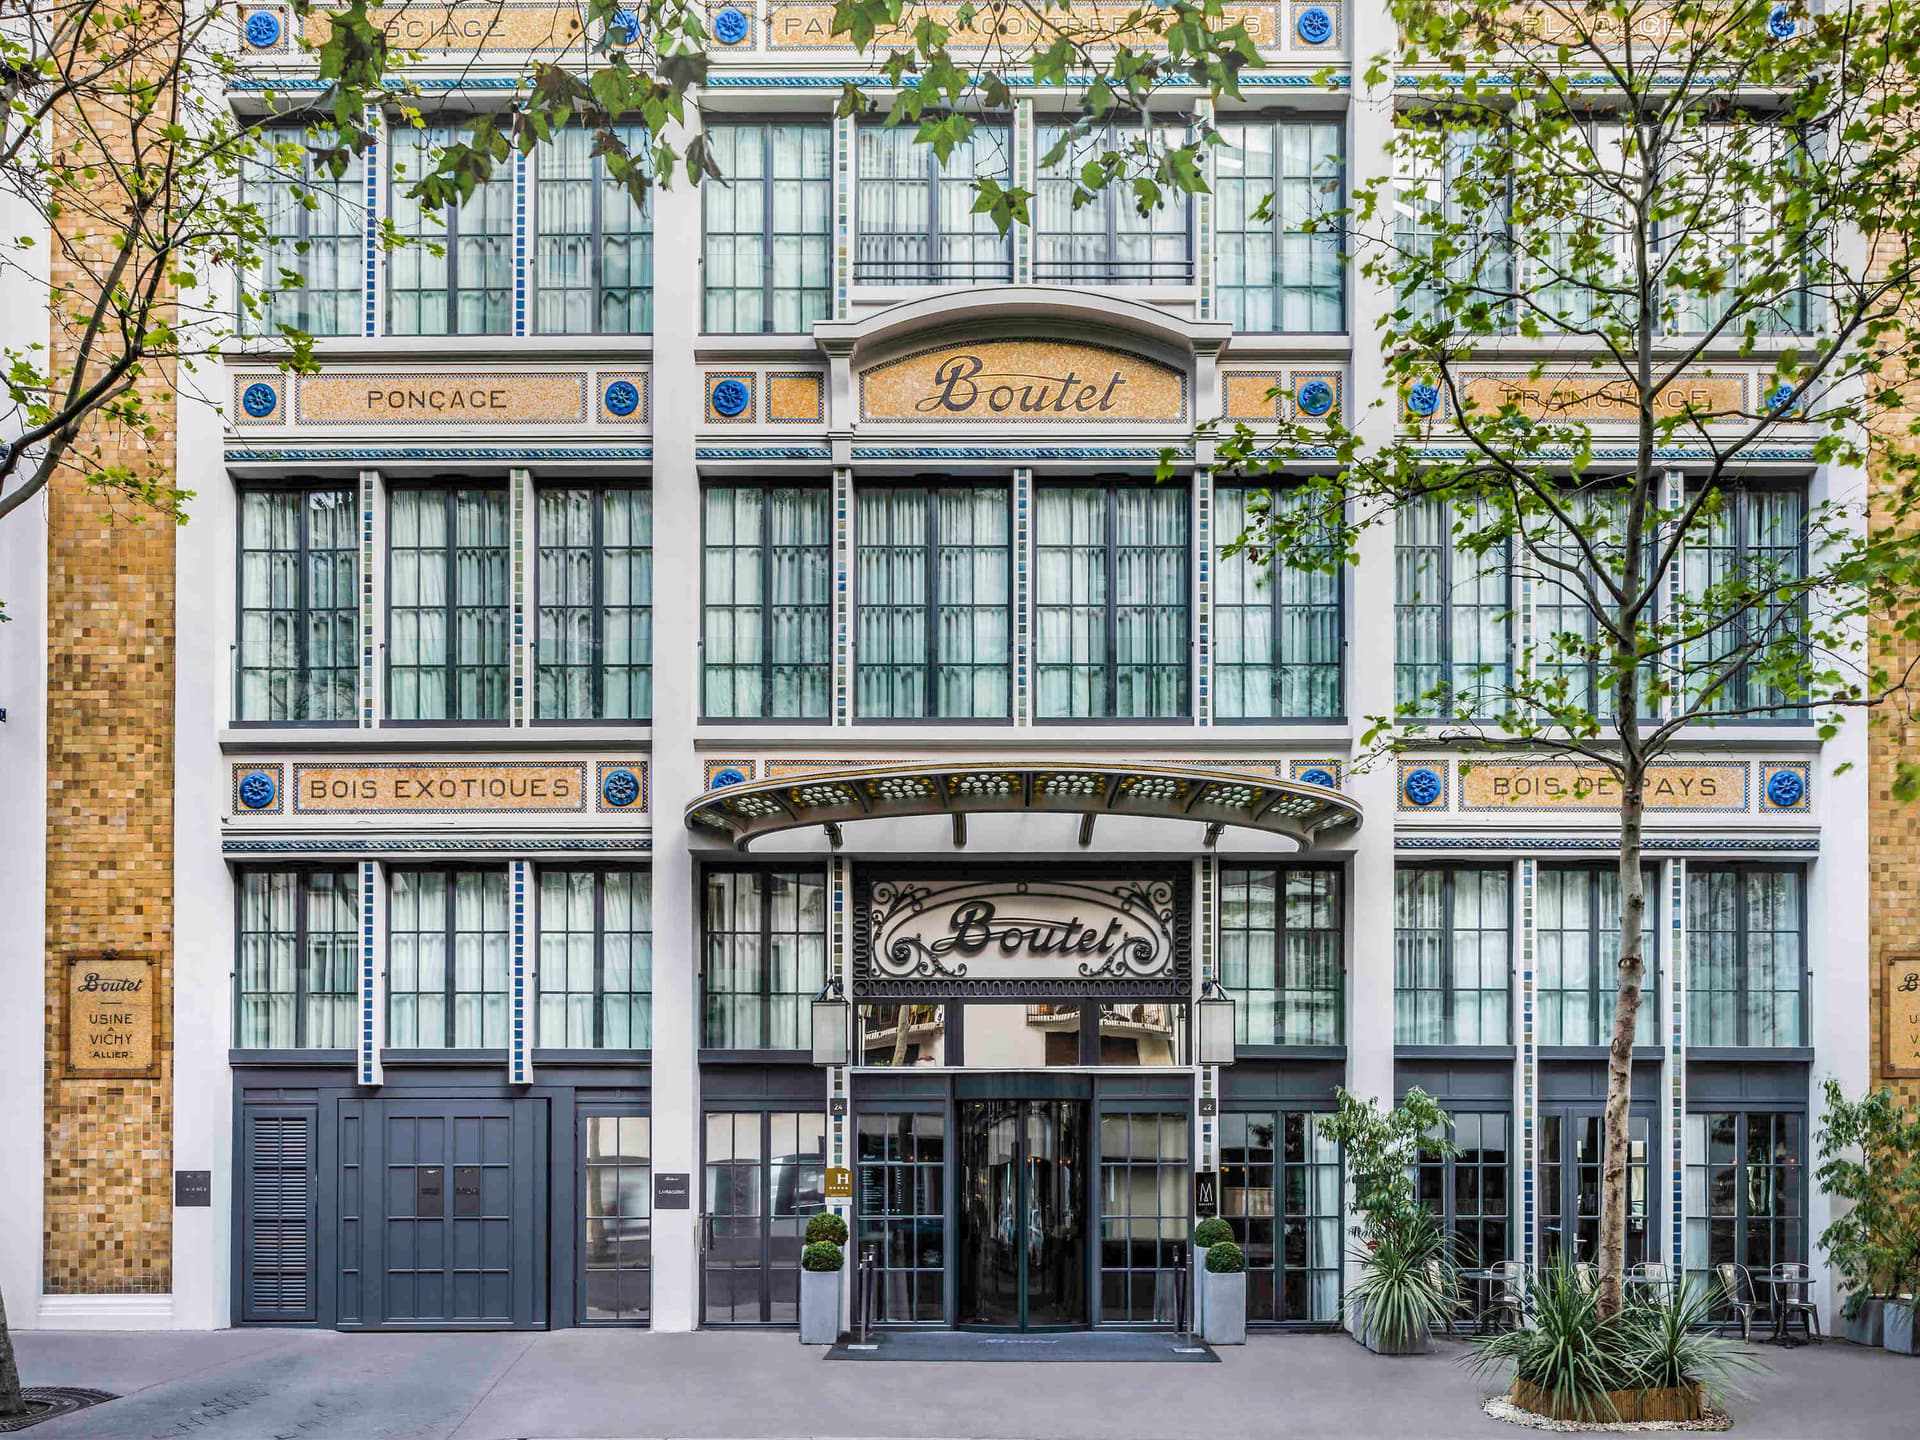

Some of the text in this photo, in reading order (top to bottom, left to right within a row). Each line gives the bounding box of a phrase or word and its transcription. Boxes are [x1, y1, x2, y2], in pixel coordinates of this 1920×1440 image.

[383, 20, 506, 38] SCIAGE
[915, 354, 1128, 412] Boutet
[367, 390, 507, 411] PONÇAGE
[310, 780, 378, 798] BOIS
[1493, 777, 1561, 796] BOIS
[1577, 777, 1614, 796] DE
[931, 900, 1123, 954] Boutet
[77, 972, 144, 992] Boutet
[89, 1013, 133, 1025] USINE
[90, 1033, 132, 1045] VICHY
[837, 1173, 849, 1185] H
